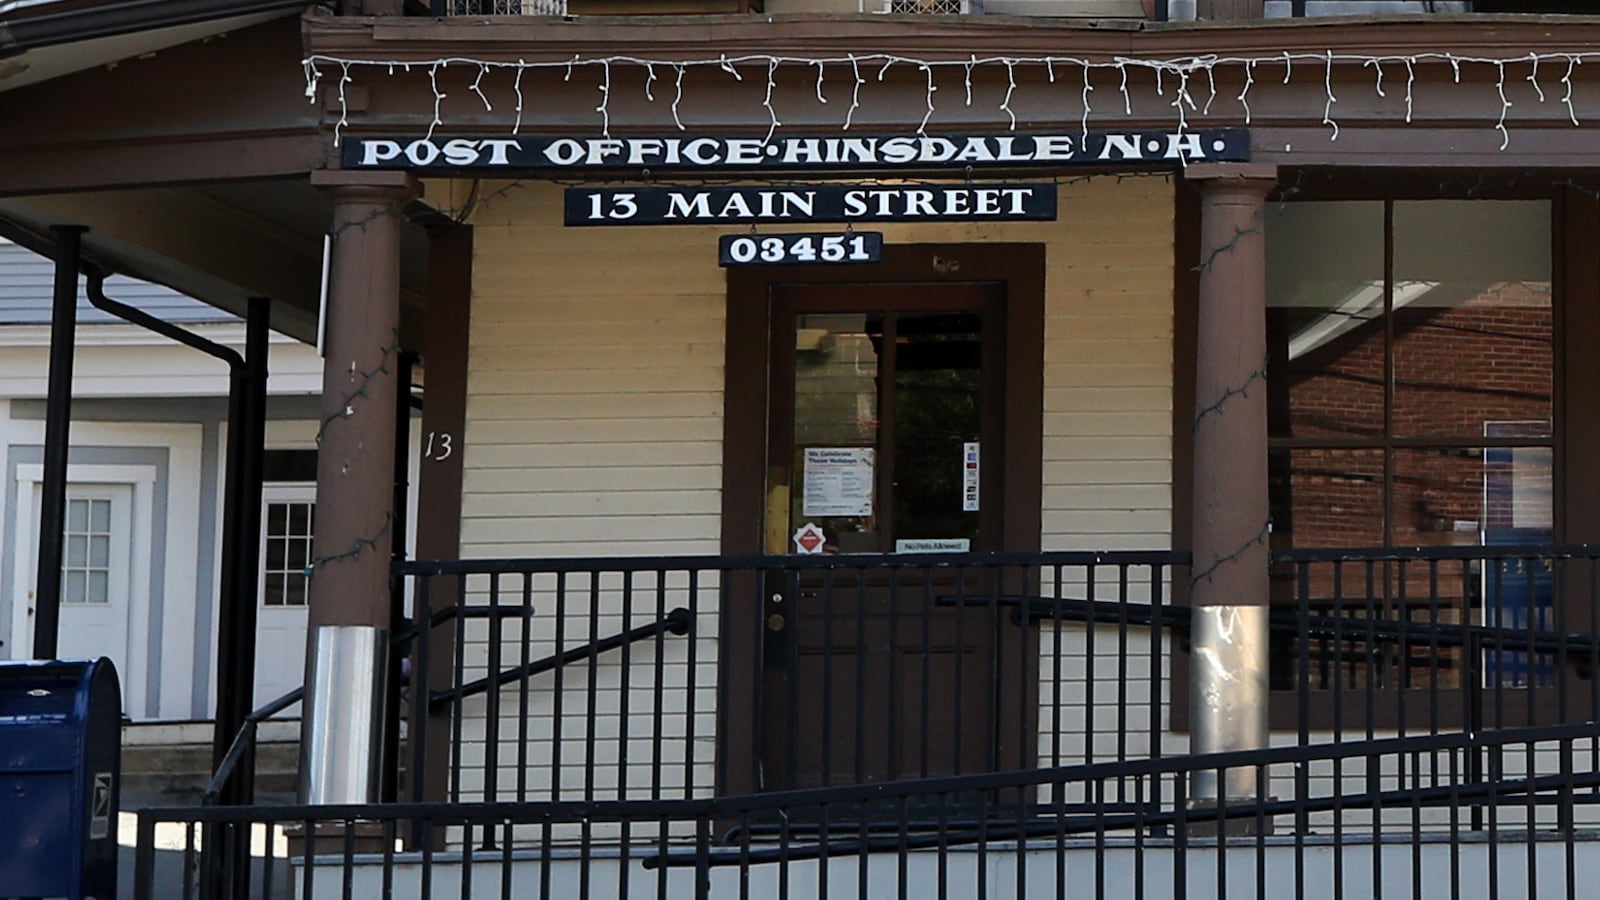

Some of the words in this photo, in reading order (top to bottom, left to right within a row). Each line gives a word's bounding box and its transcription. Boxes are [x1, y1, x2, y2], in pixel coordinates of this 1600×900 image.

[359, 138, 522, 166] POST
[587, 193, 639, 219] 13
[663, 191, 817, 218] MAIN
[844, 189, 1034, 216] STREET
[730, 235, 870, 263] 03451
[424, 431, 453, 461] 13
[932, 542, 962, 550] Allowed
